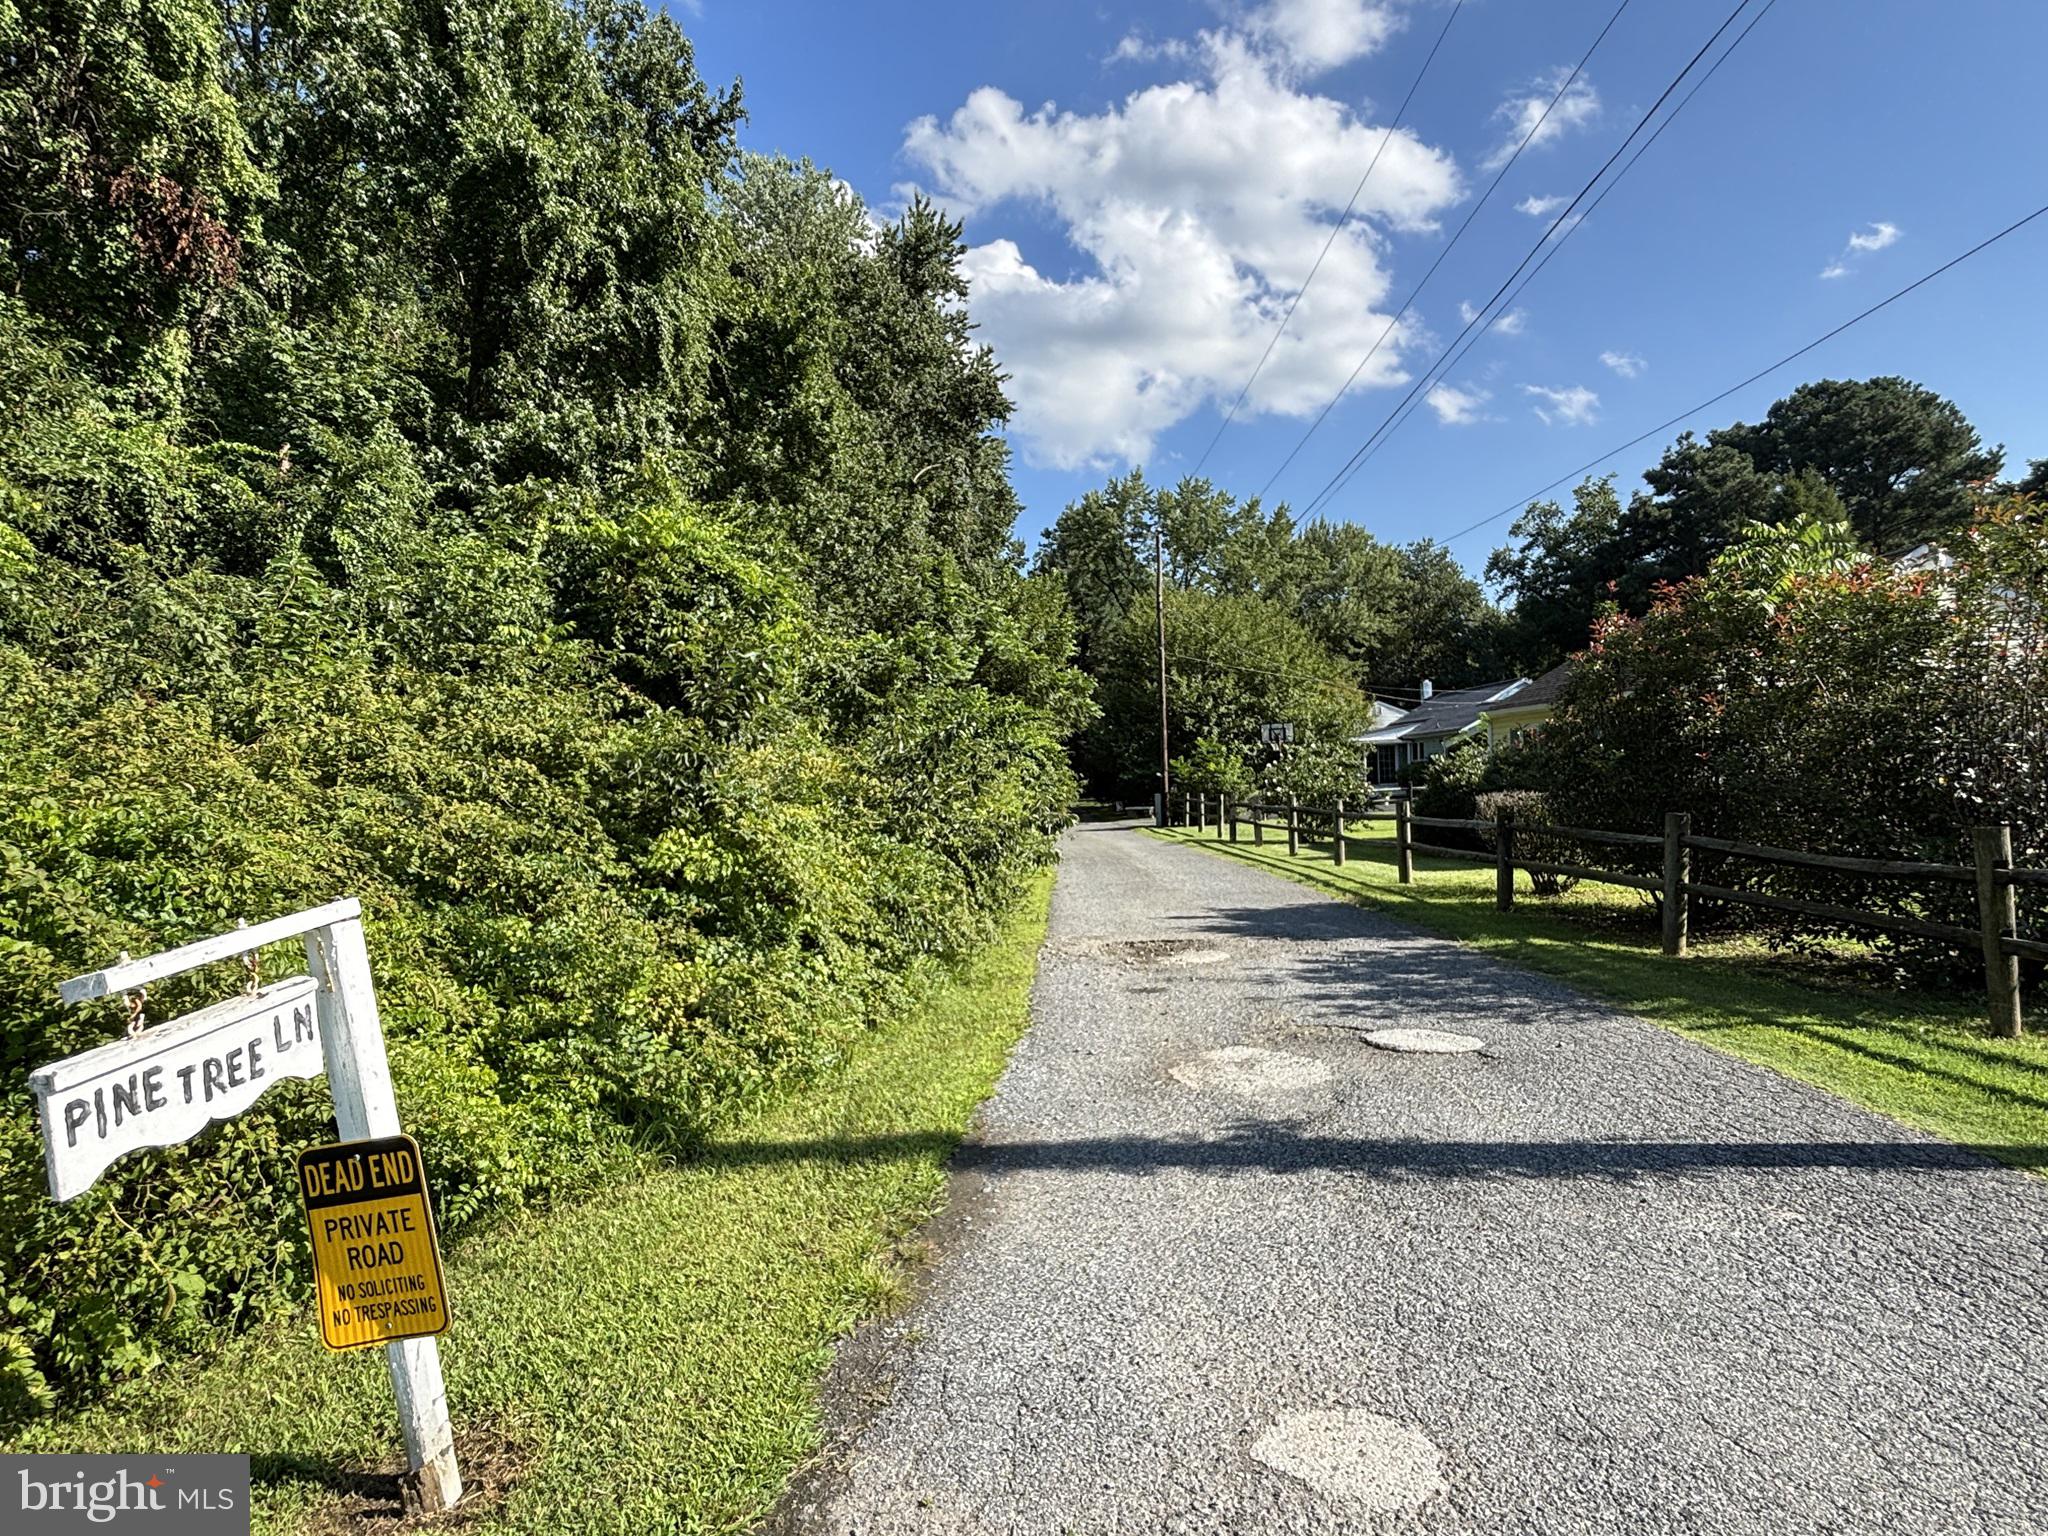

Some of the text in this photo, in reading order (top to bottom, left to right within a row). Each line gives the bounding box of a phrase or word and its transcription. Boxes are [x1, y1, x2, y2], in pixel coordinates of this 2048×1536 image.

[64, 1003, 314, 1148] PINE TREE LN
[304, 1150, 414, 1198] DEAD END
[324, 1208, 416, 1243] PRIVATE
[347, 1241, 404, 1271] ROAD
[338, 1274, 425, 1302] NO SOLICITING
[333, 1296, 437, 1328] NO TRESPASSING
